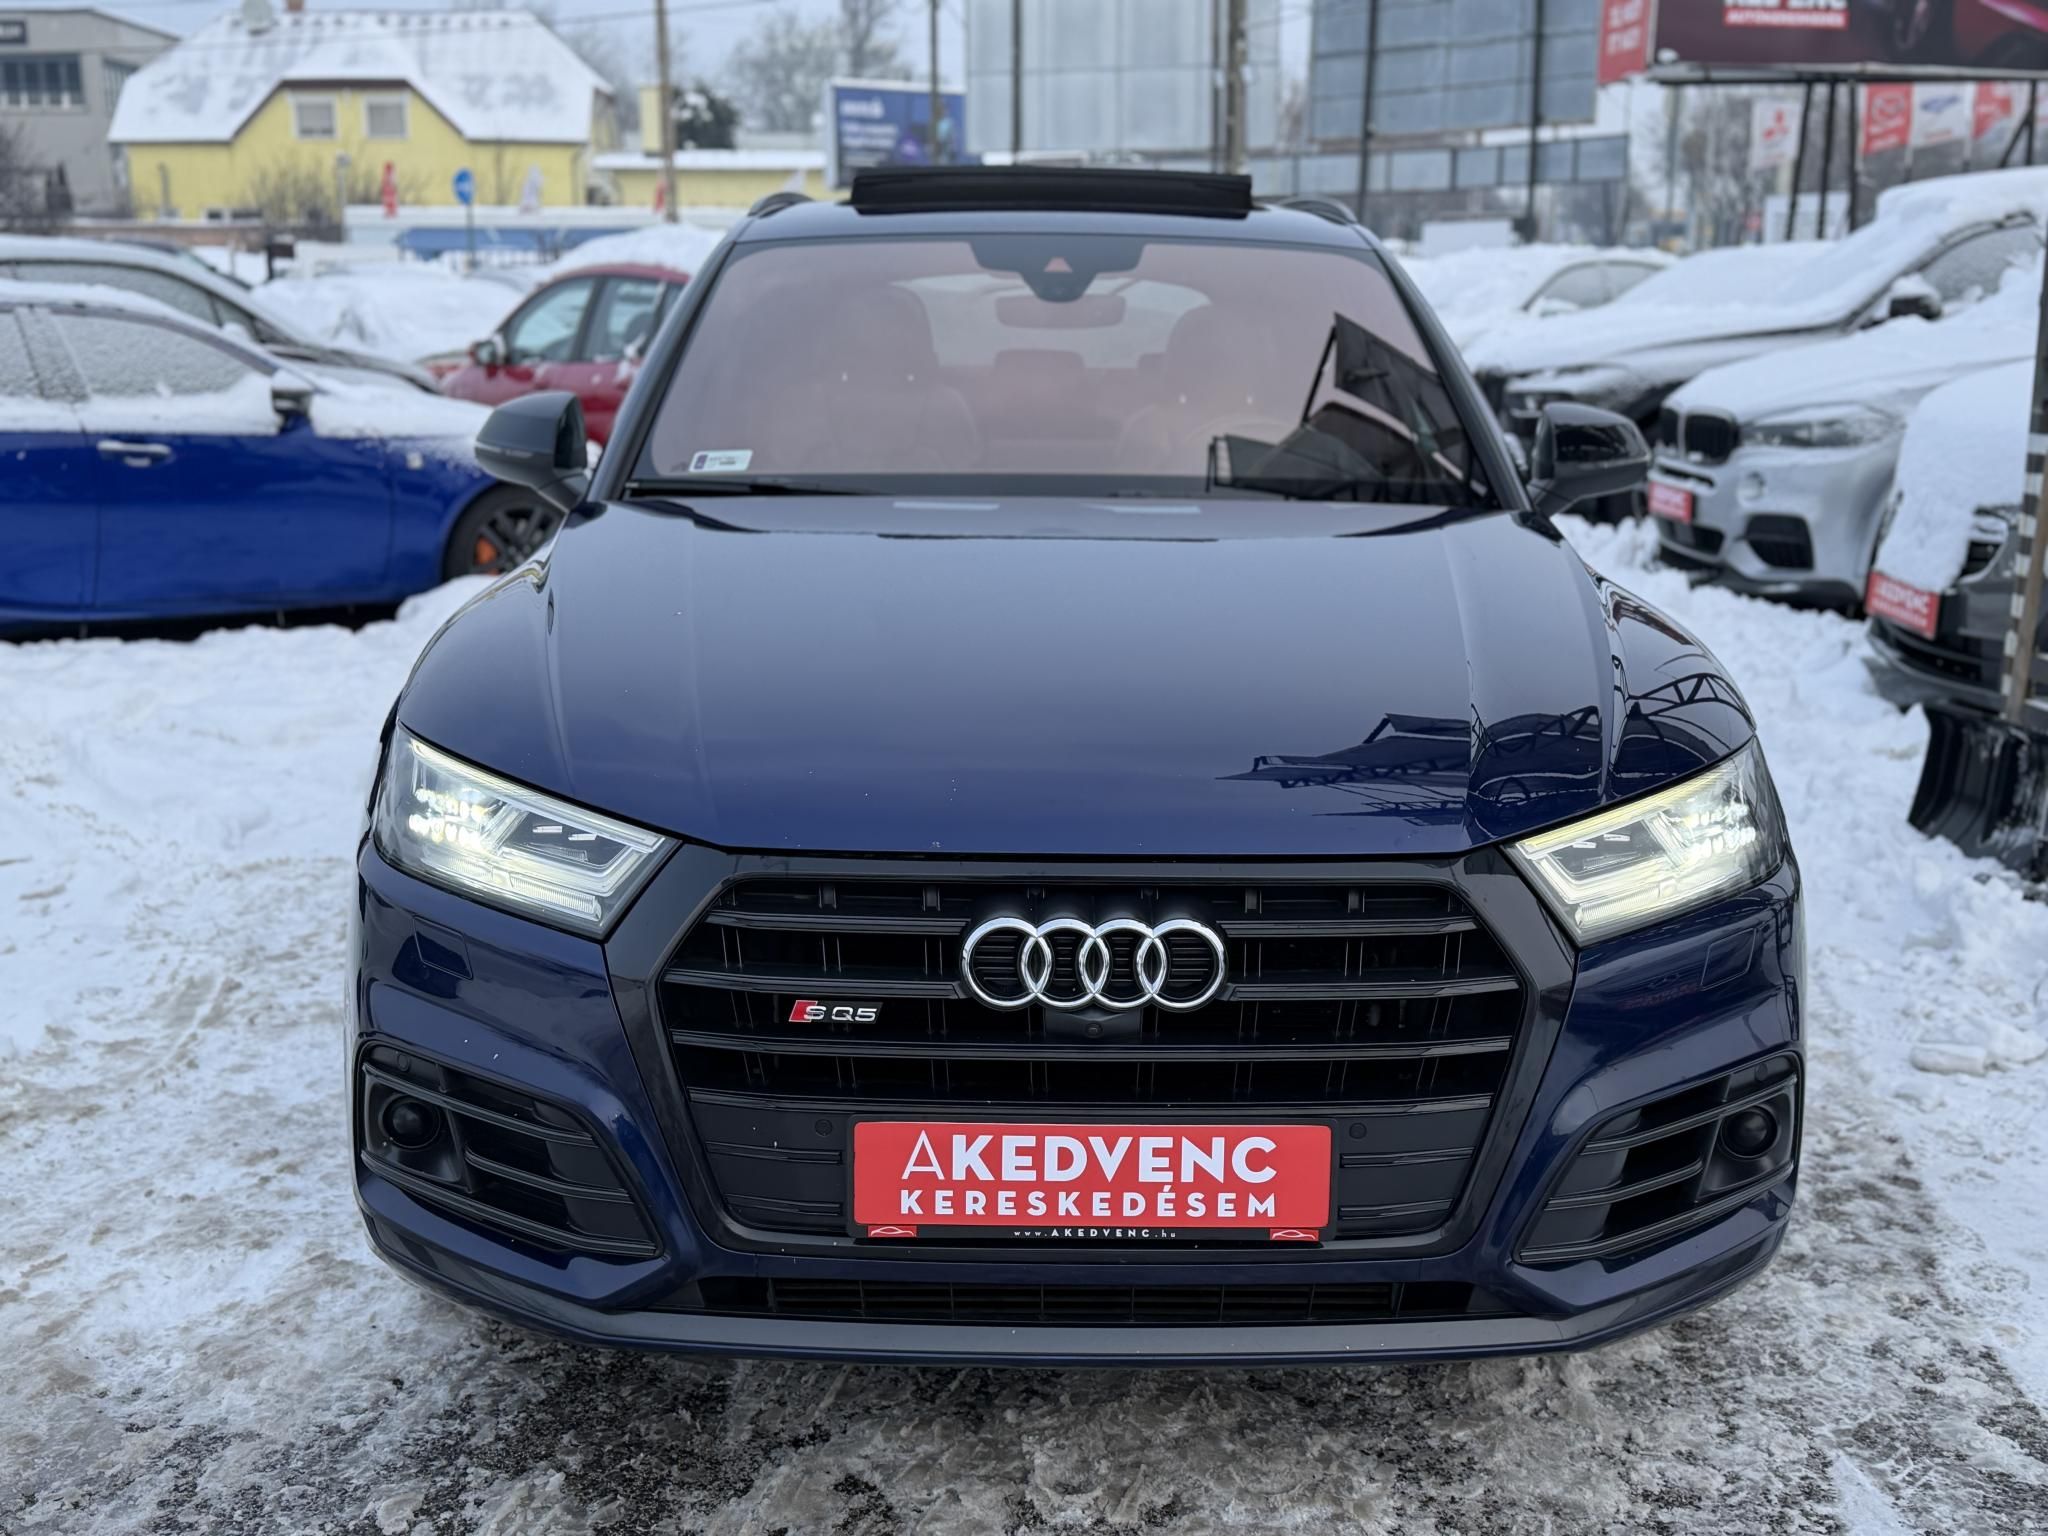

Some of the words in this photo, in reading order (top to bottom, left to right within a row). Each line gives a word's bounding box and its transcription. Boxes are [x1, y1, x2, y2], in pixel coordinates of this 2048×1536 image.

[901, 1129, 1277, 1184] AKEDVENC
[900, 1184, 1276, 1218] KERESKEDÉSEM
[1013, 1228, 1176, 1239] www.AKEDVENC.hu
